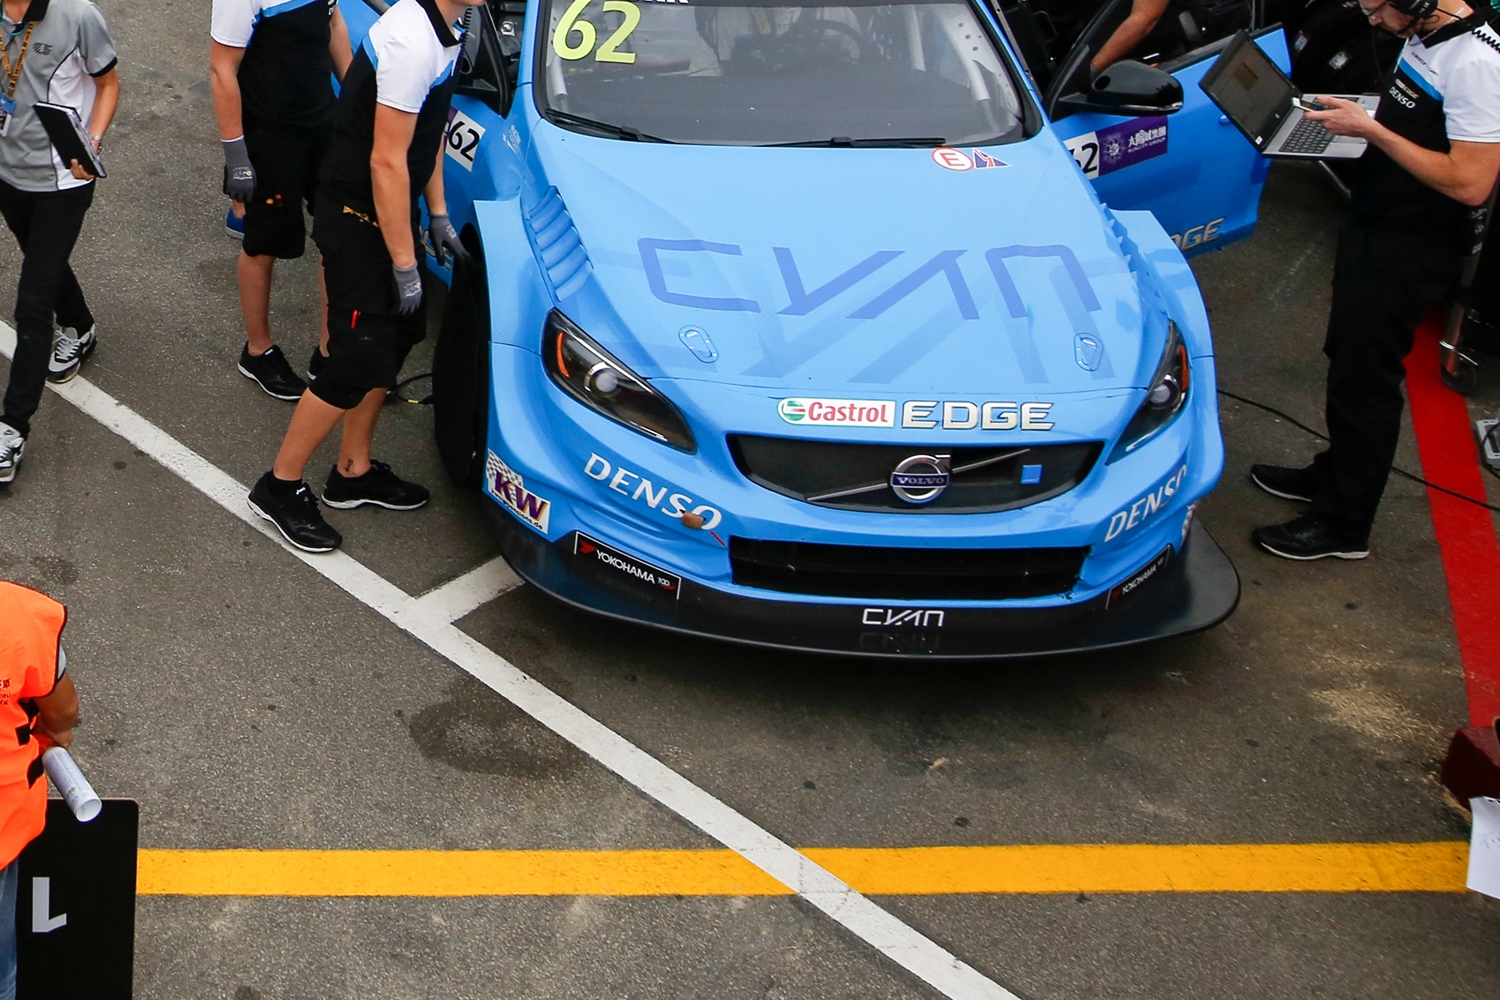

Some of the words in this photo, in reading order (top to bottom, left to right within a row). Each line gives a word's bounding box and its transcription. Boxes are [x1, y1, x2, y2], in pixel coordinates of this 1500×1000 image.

[1388, 86, 1417, 109] DENSO
[448, 120, 481, 163] 62
[1128, 142, 1149, 154] SUNCITY
[1148, 137, 1167, 148] GROUP
[941, 148, 970, 168] E
[807, 402, 889, 425] Castrol
[901, 401, 1056, 432] EDGE
[583, 451, 722, 532] DENSO
[895, 476, 946, 488] VOLVO
[494, 471, 549, 522] KW
[596, 550, 656, 584] YOKOHAMA
[862, 608, 944, 628] CYAN
